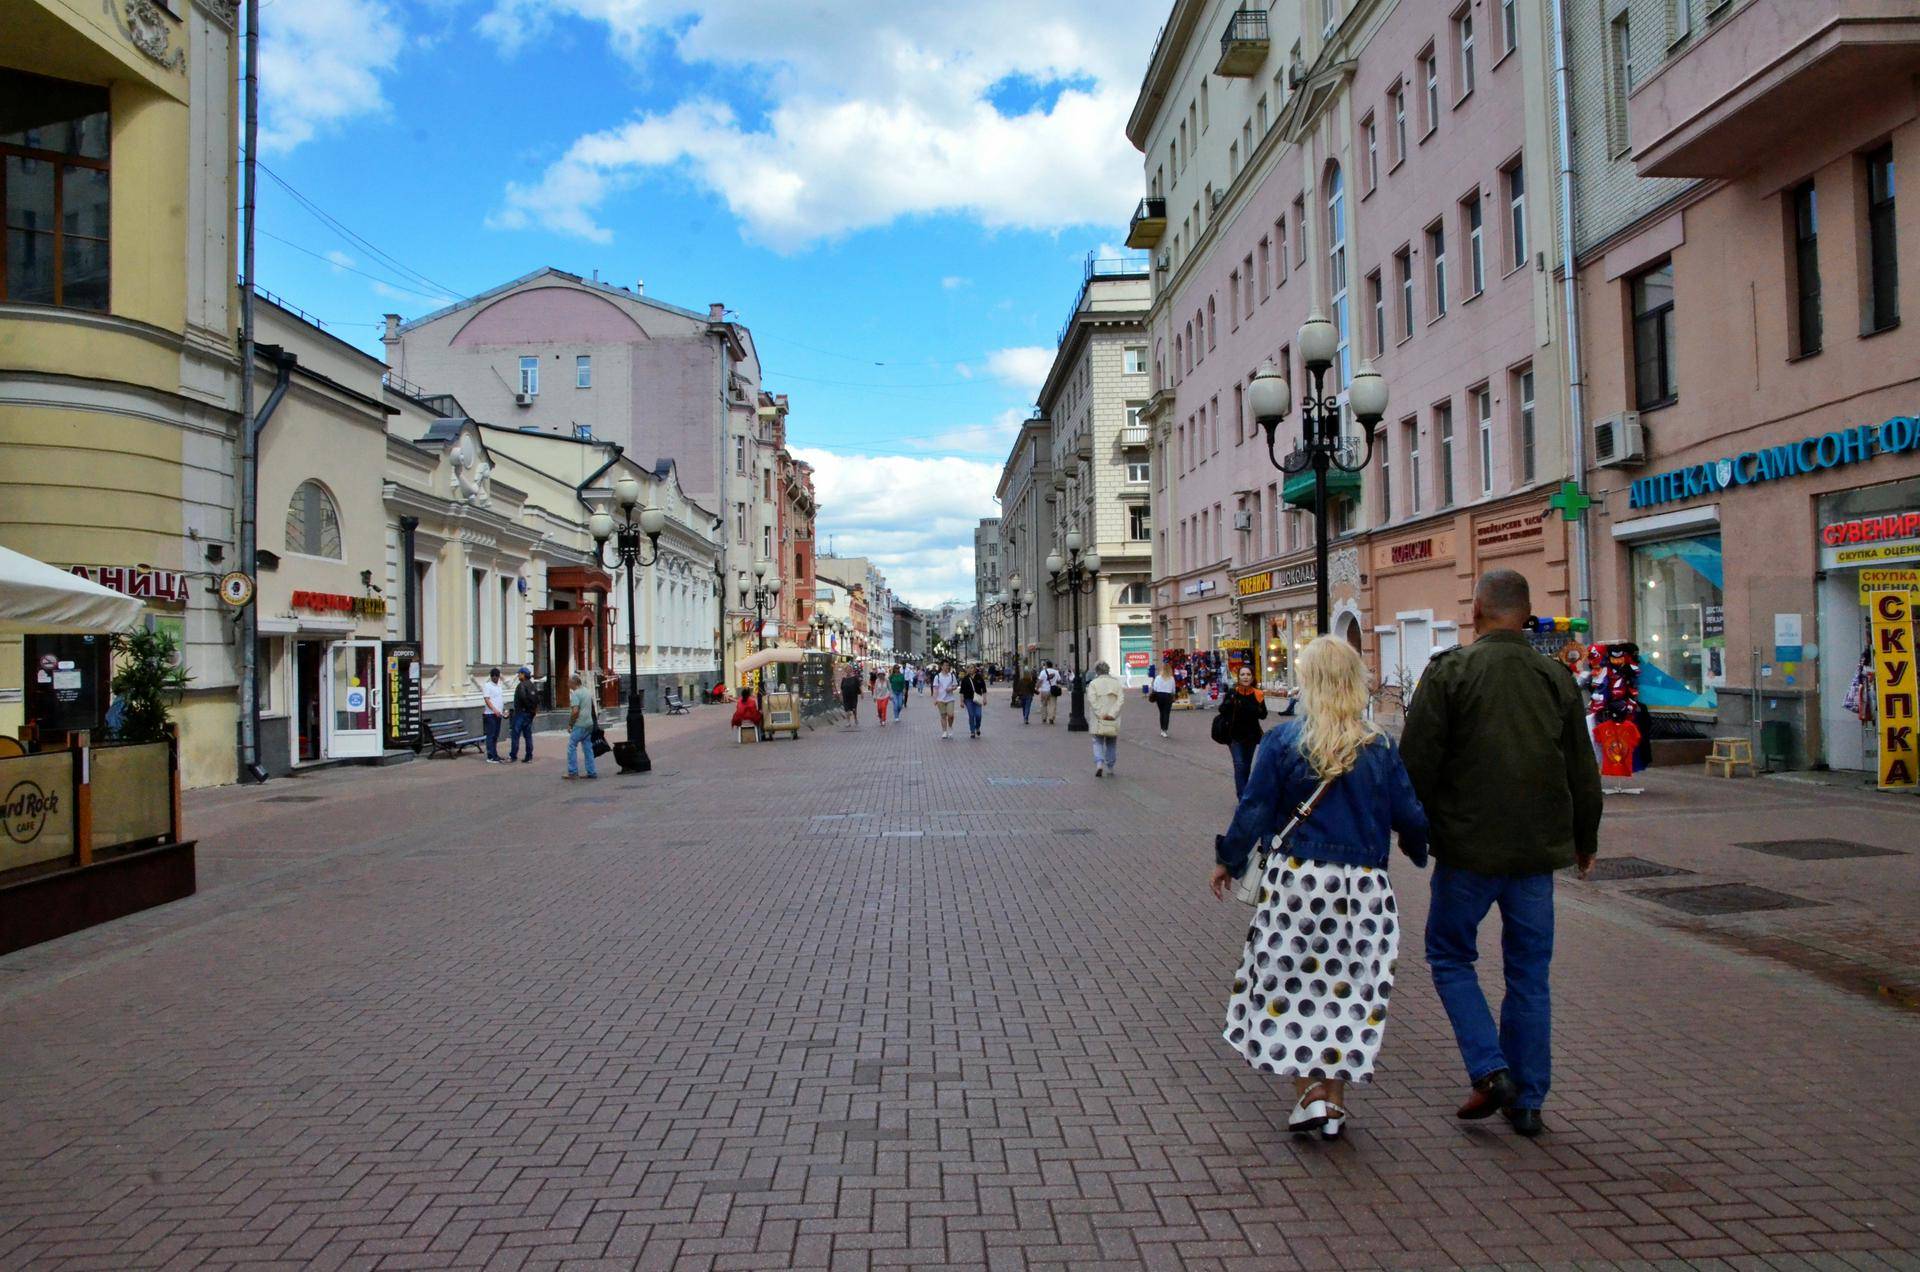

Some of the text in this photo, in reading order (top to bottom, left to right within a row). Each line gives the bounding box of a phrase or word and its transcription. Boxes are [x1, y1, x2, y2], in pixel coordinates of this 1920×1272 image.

[1629, 461, 1717, 509] АПТЕКА
[1391, 538, 1433, 565] КОНСУЛ
[1838, 549, 1878, 561] СКУПКА
[1862, 571, 1918, 582] СКУПКА
[1878, 595, 1913, 785] СКУПКА
[26, 790, 59, 818] Rock
[16, 821, 35, 833] CAFE
